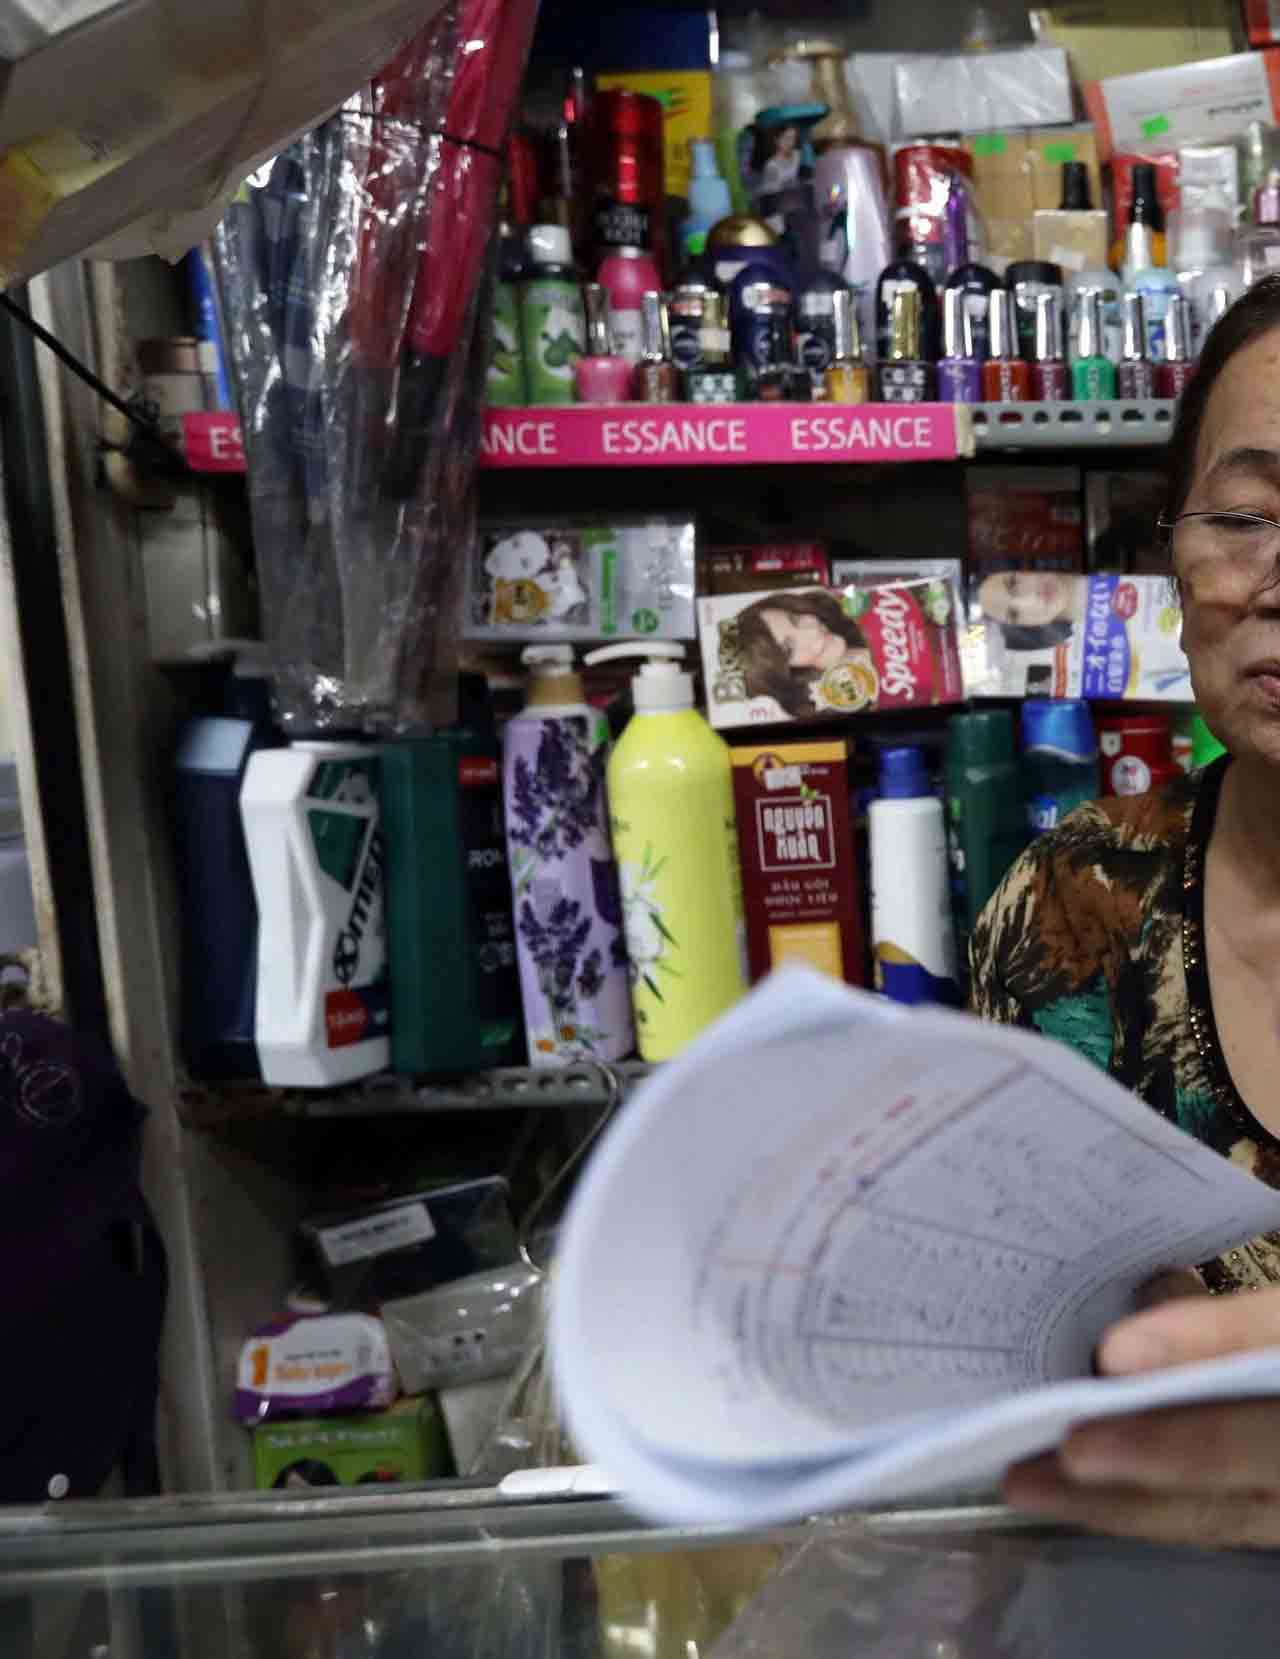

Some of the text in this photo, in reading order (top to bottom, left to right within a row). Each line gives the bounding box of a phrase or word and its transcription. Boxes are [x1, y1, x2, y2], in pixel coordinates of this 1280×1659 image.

[481, 423, 557, 455] ANCE
[601, 420, 747, 454] ESSANCE
[790, 416, 932, 451] ESSANCE
[874, 582, 917, 700] Speedy
